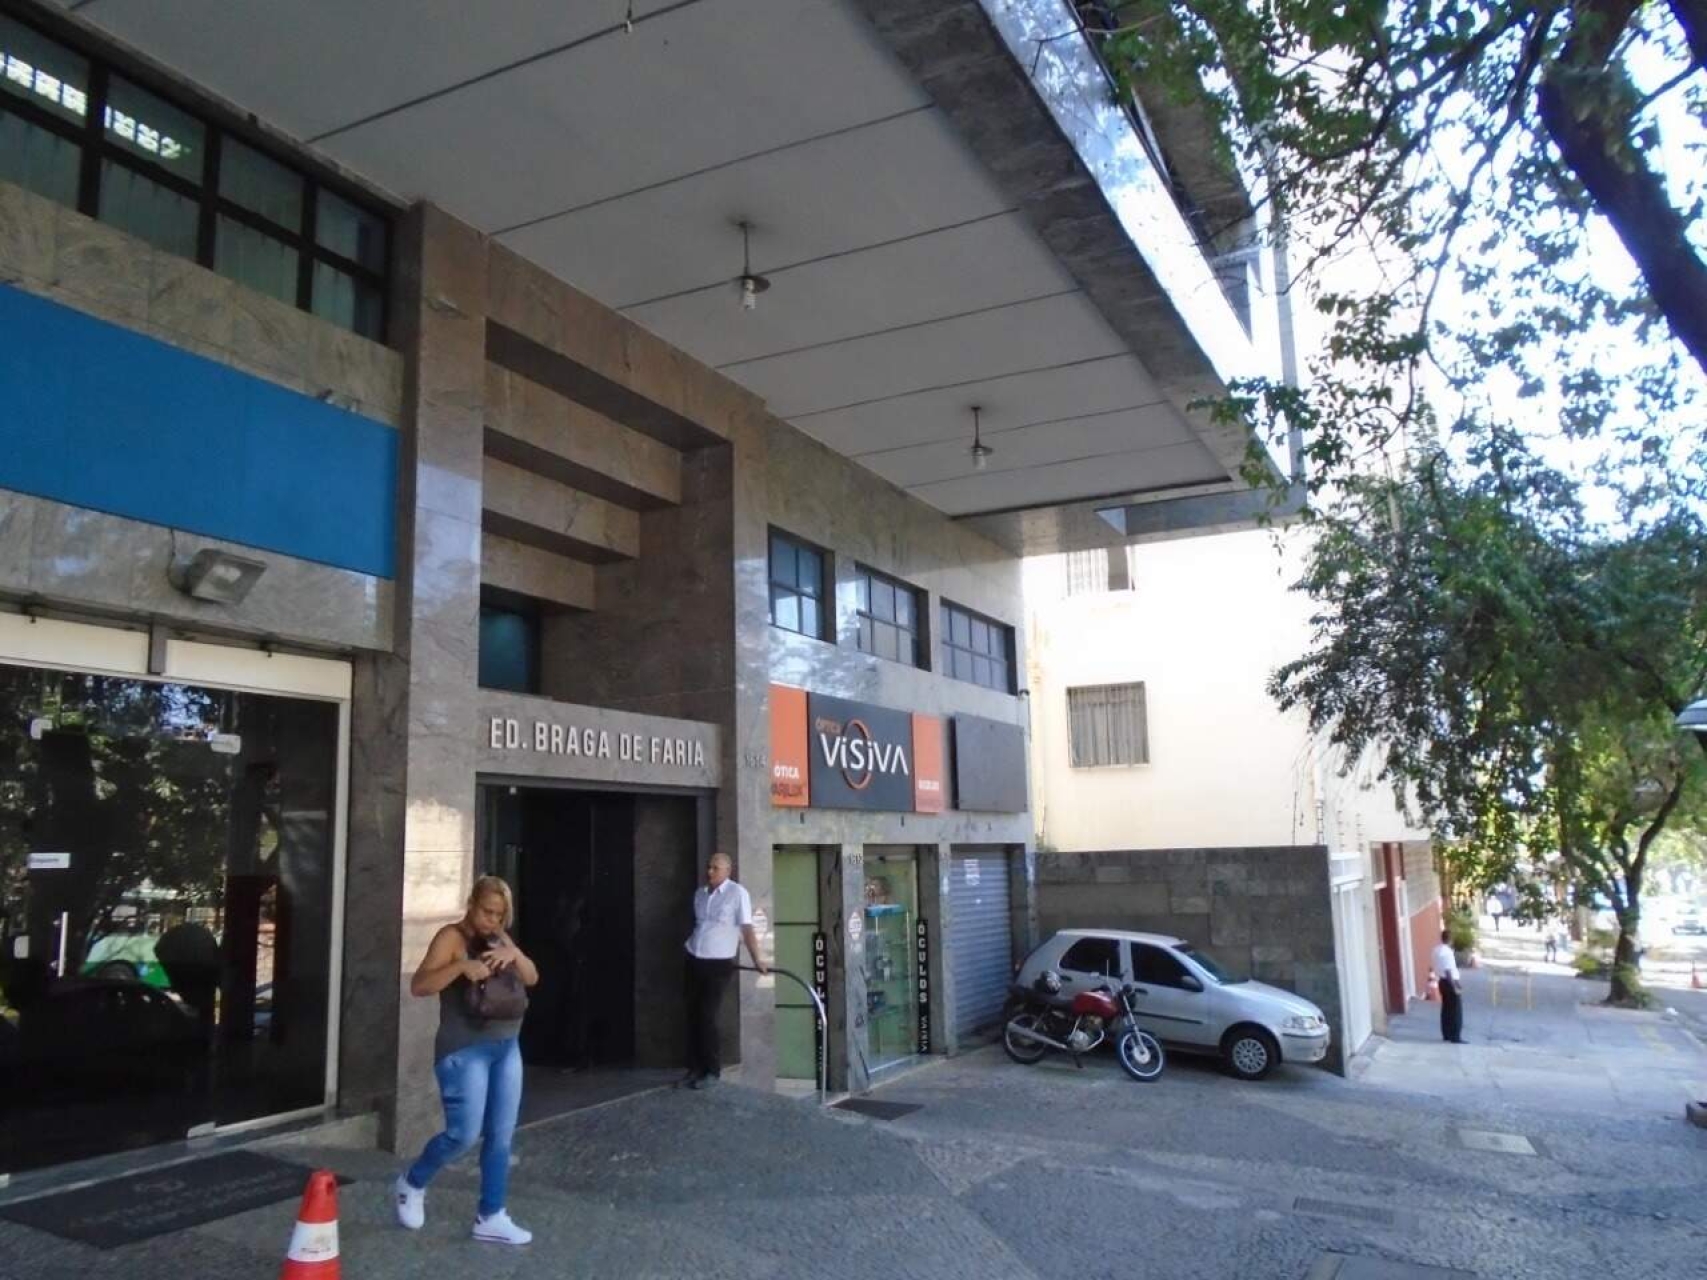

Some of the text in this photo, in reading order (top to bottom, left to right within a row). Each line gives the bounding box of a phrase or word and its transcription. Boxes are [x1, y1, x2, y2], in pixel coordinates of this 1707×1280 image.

[491, 717, 705, 767] ED. BRAGA DE FARIA
